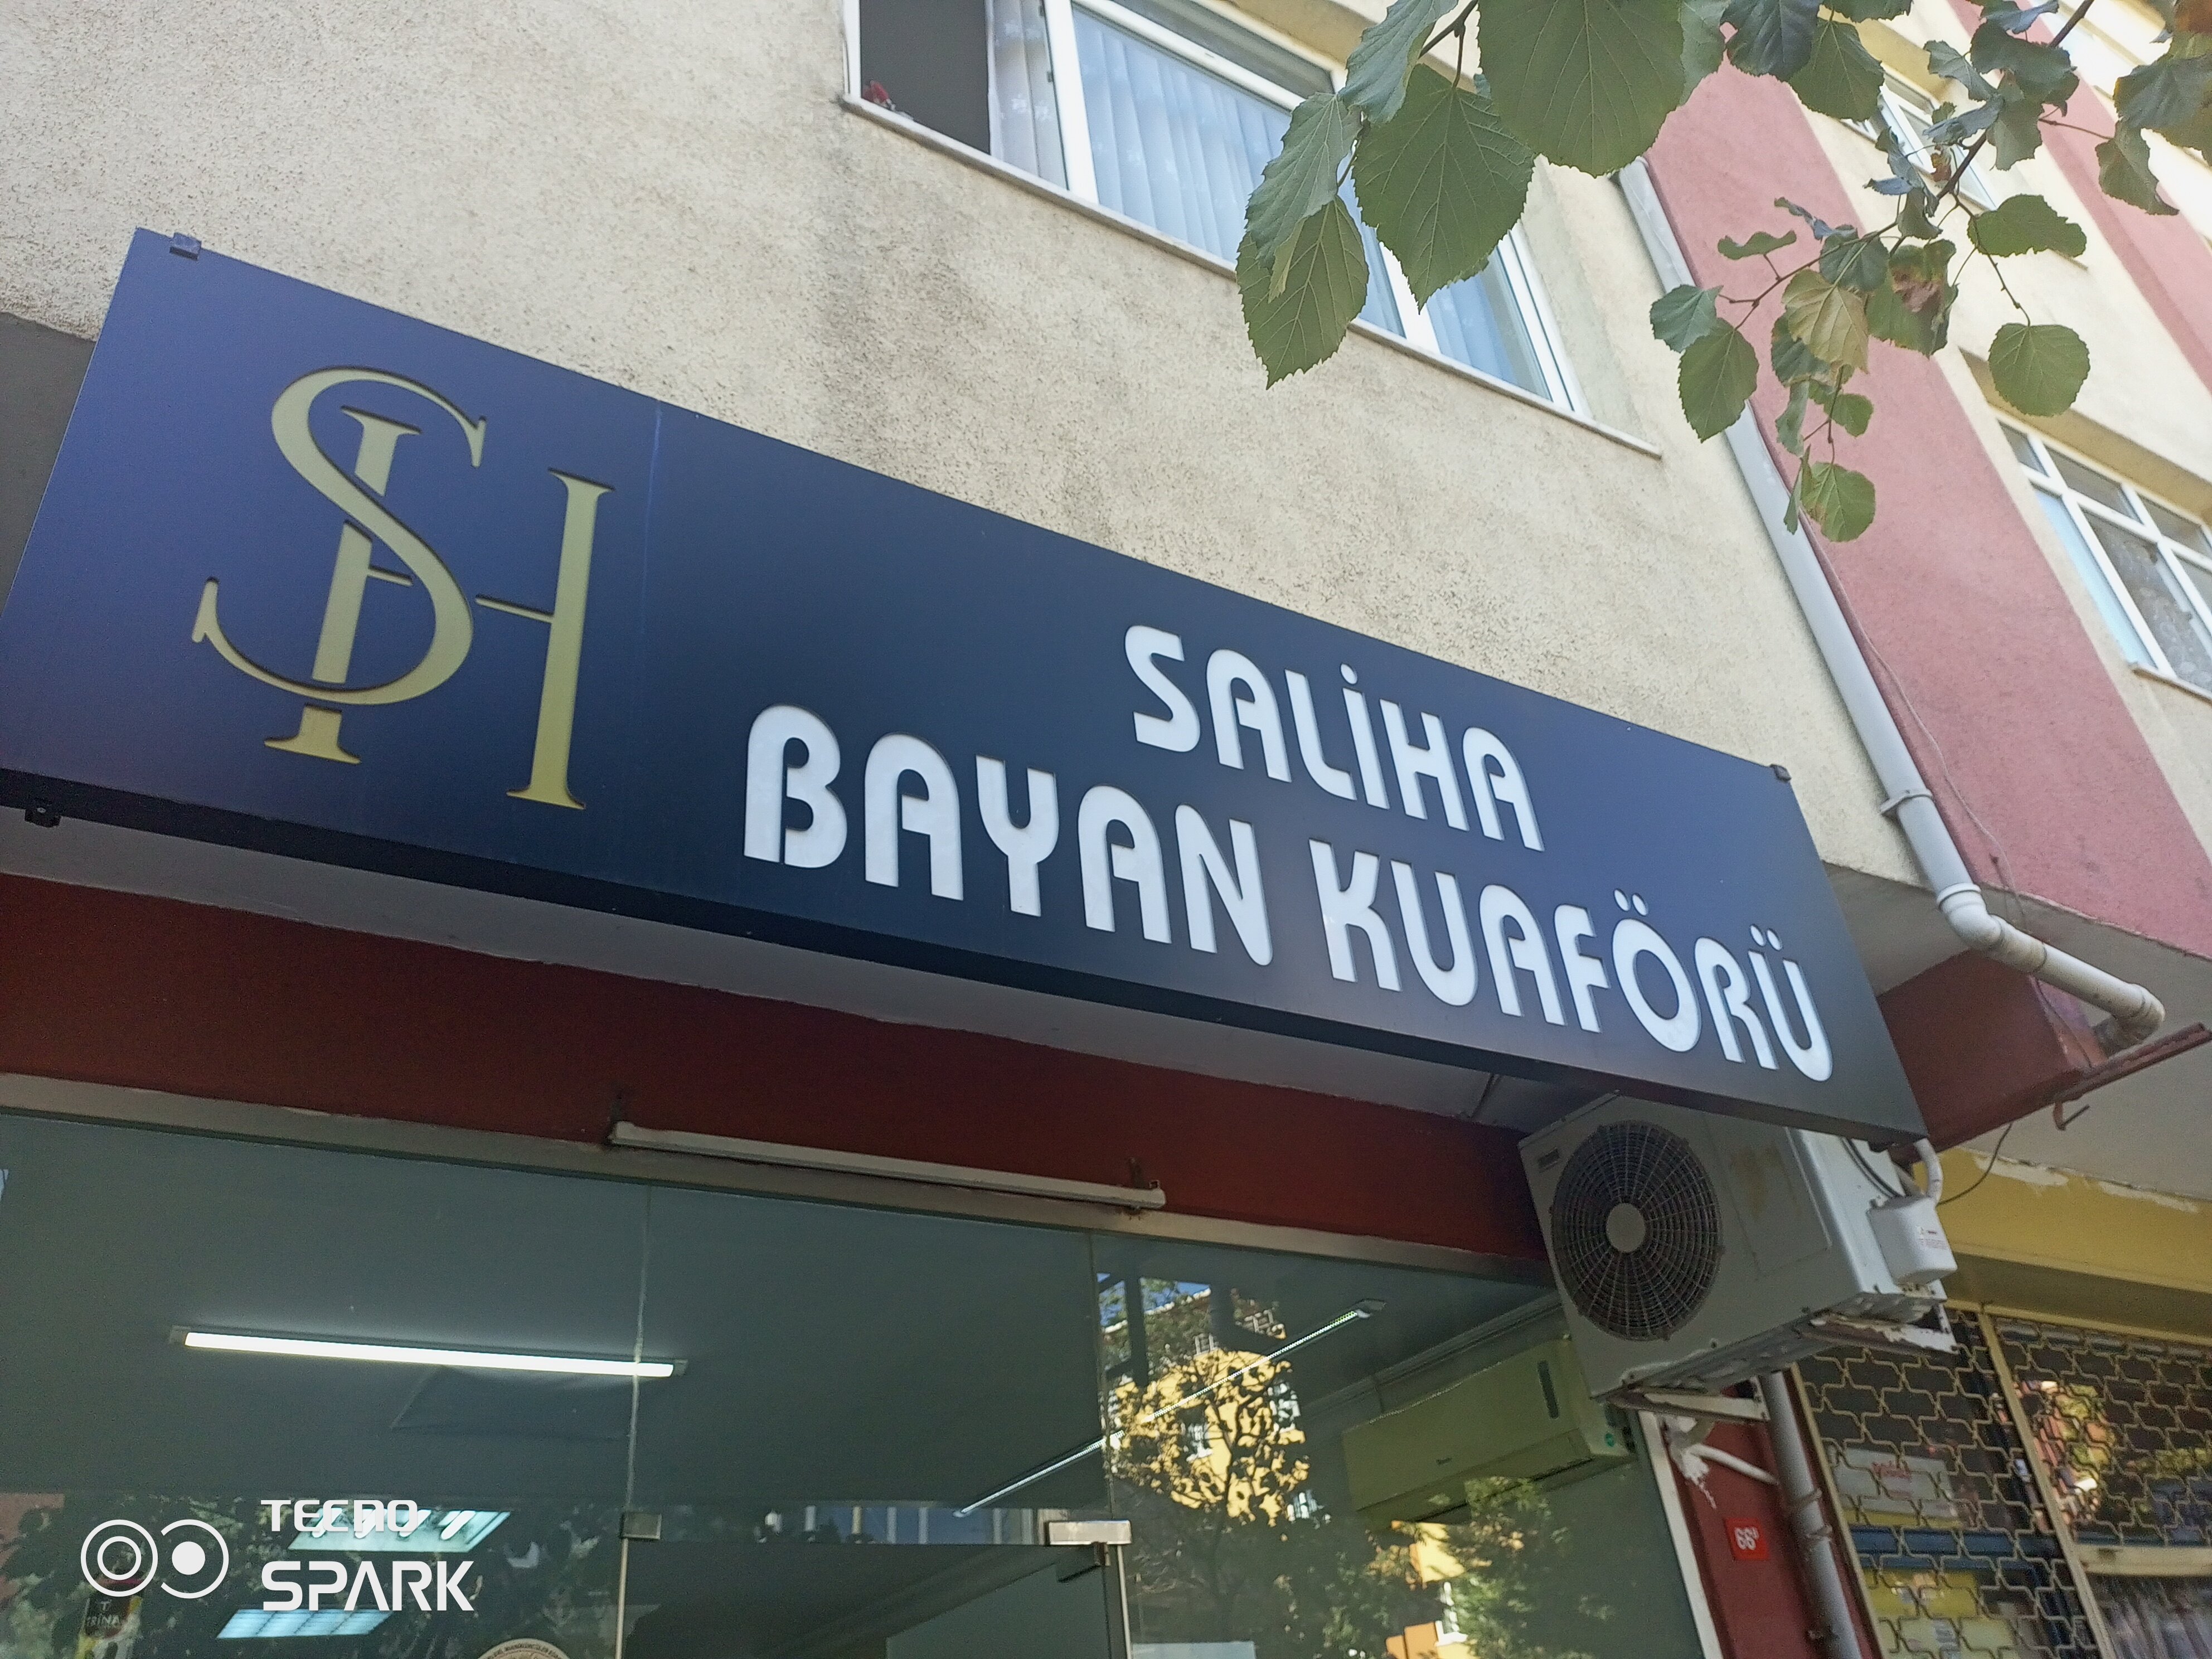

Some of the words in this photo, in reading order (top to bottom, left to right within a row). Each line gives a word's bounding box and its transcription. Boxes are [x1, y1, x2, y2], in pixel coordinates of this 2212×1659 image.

[1125, 625, 1543, 852] SALİHA
[744, 704, 1273, 966] BAYAN
[1308, 838, 1833, 1082] KUAFÖRÜ
